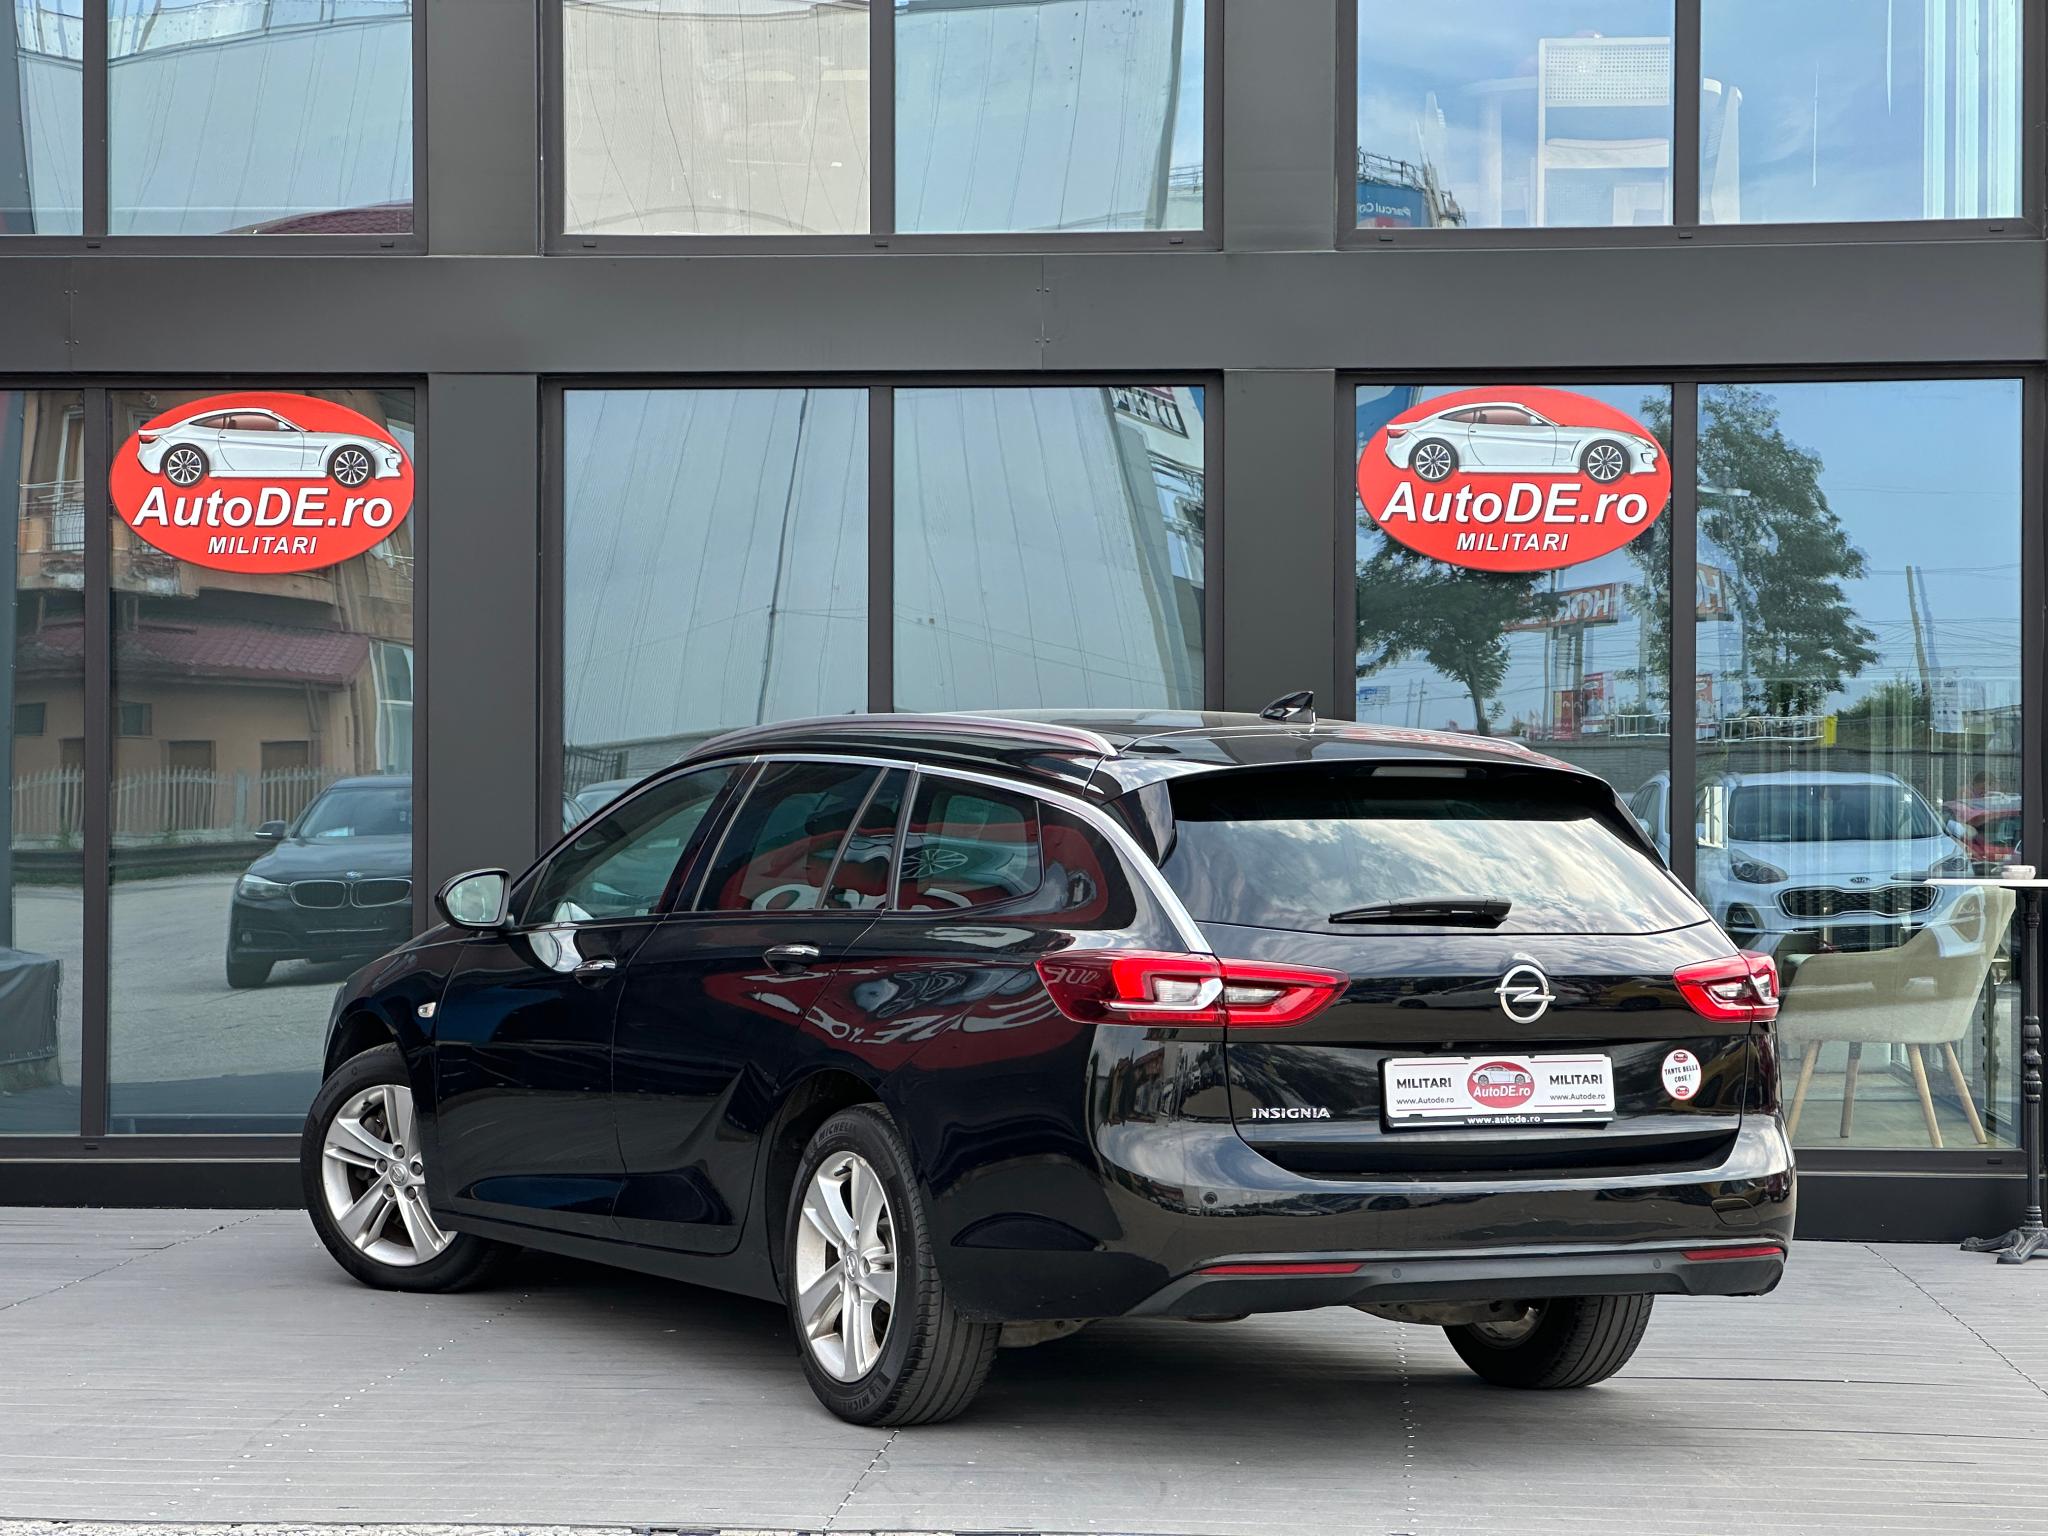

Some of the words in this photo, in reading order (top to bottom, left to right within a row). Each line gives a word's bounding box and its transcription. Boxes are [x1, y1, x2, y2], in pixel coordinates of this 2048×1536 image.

[132, 487, 394, 527] AutoDE.ro
[1379, 481, 1649, 524] AutoDE.ro
[207, 536, 317, 554] MILITARI
[1456, 533, 1570, 551] MILITARI
[1664, 1067, 1682, 1075] TANTE
[1396, 1077, 1452, 1089] MILITARI
[1549, 1074, 1603, 1085] MILITARI
[1473, 1086, 1531, 1098] AutoDE.ro
[1549, 1092, 1606, 1101] www.Autode.ro
[1396, 1096, 1455, 1105] www.Autode.ro
[1251, 1107, 1331, 1119] INSIGNIA
[1467, 1115, 1541, 1125] www.autode.ro
